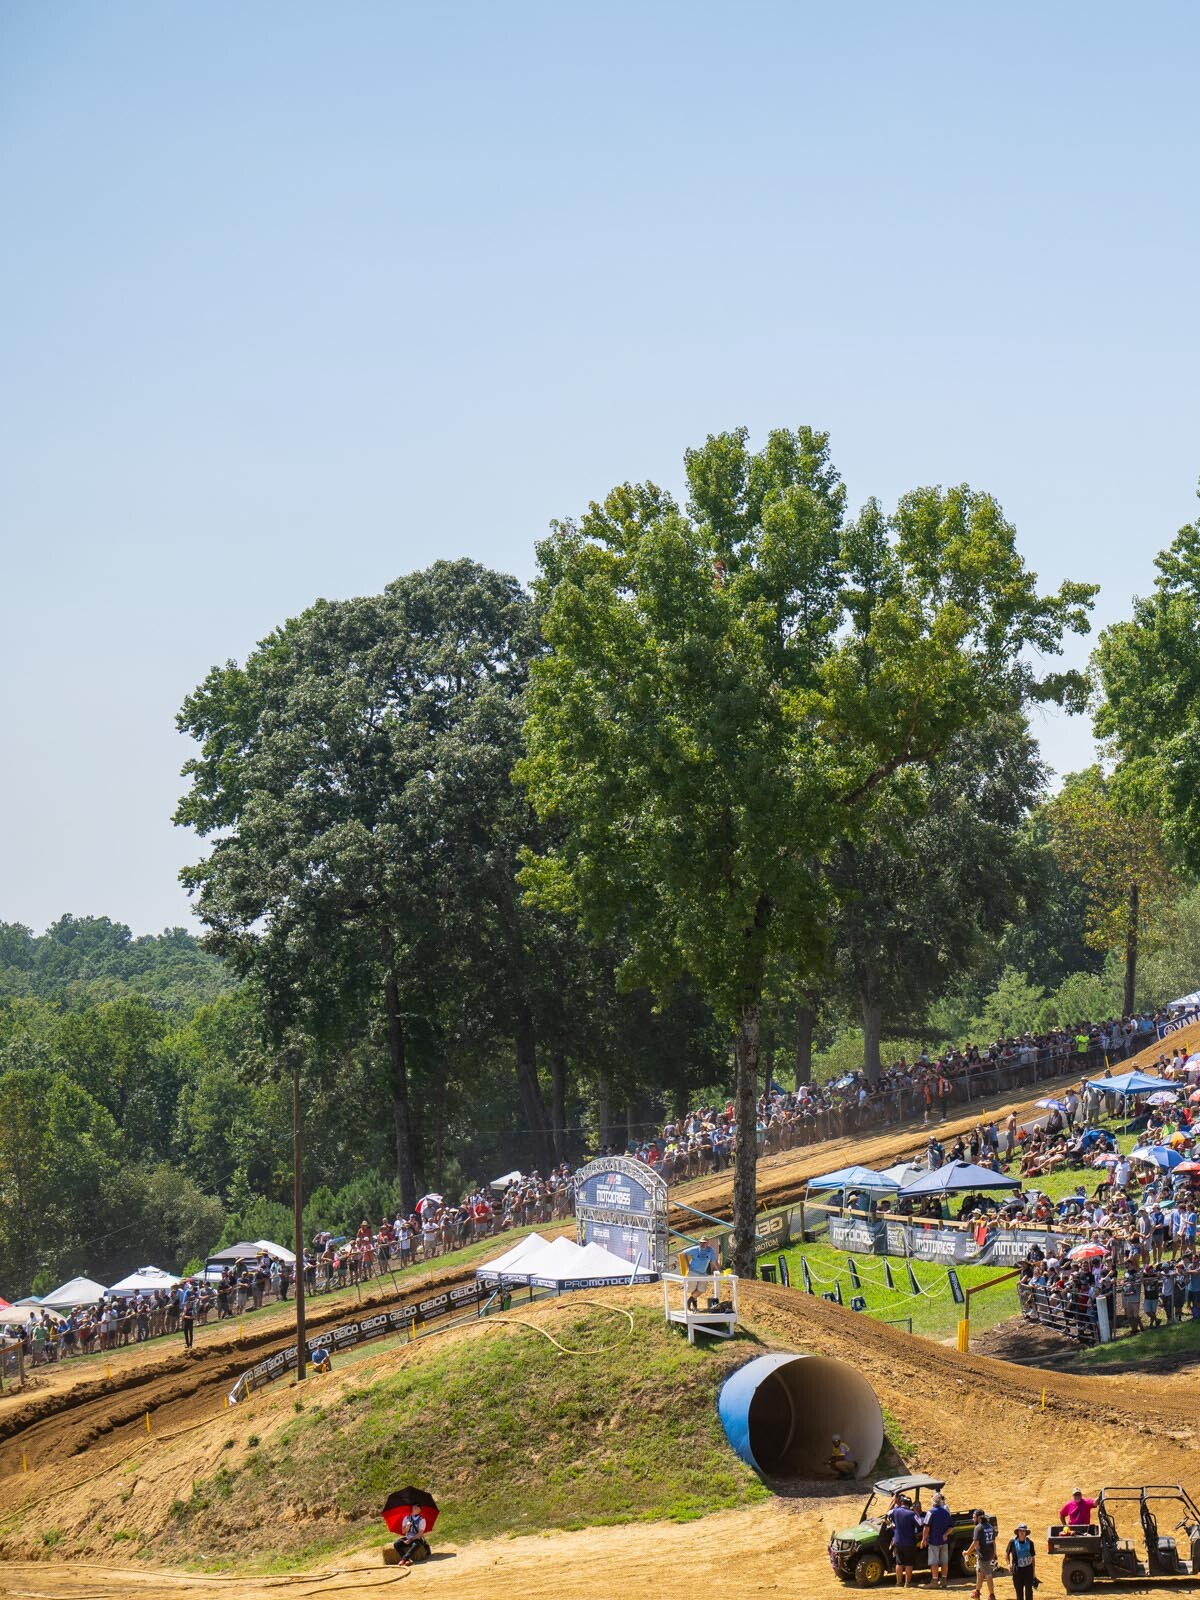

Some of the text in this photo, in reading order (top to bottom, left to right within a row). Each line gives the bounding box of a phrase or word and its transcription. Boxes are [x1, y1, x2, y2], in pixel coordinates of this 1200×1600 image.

[450, 1282, 482, 1300] GEICO
[420, 1294, 448, 1312] GEICO
[390, 1305, 417, 1321] GEICO
[360, 1315, 388, 1331] GEICO
[333, 1324, 359, 1340] GEICO
